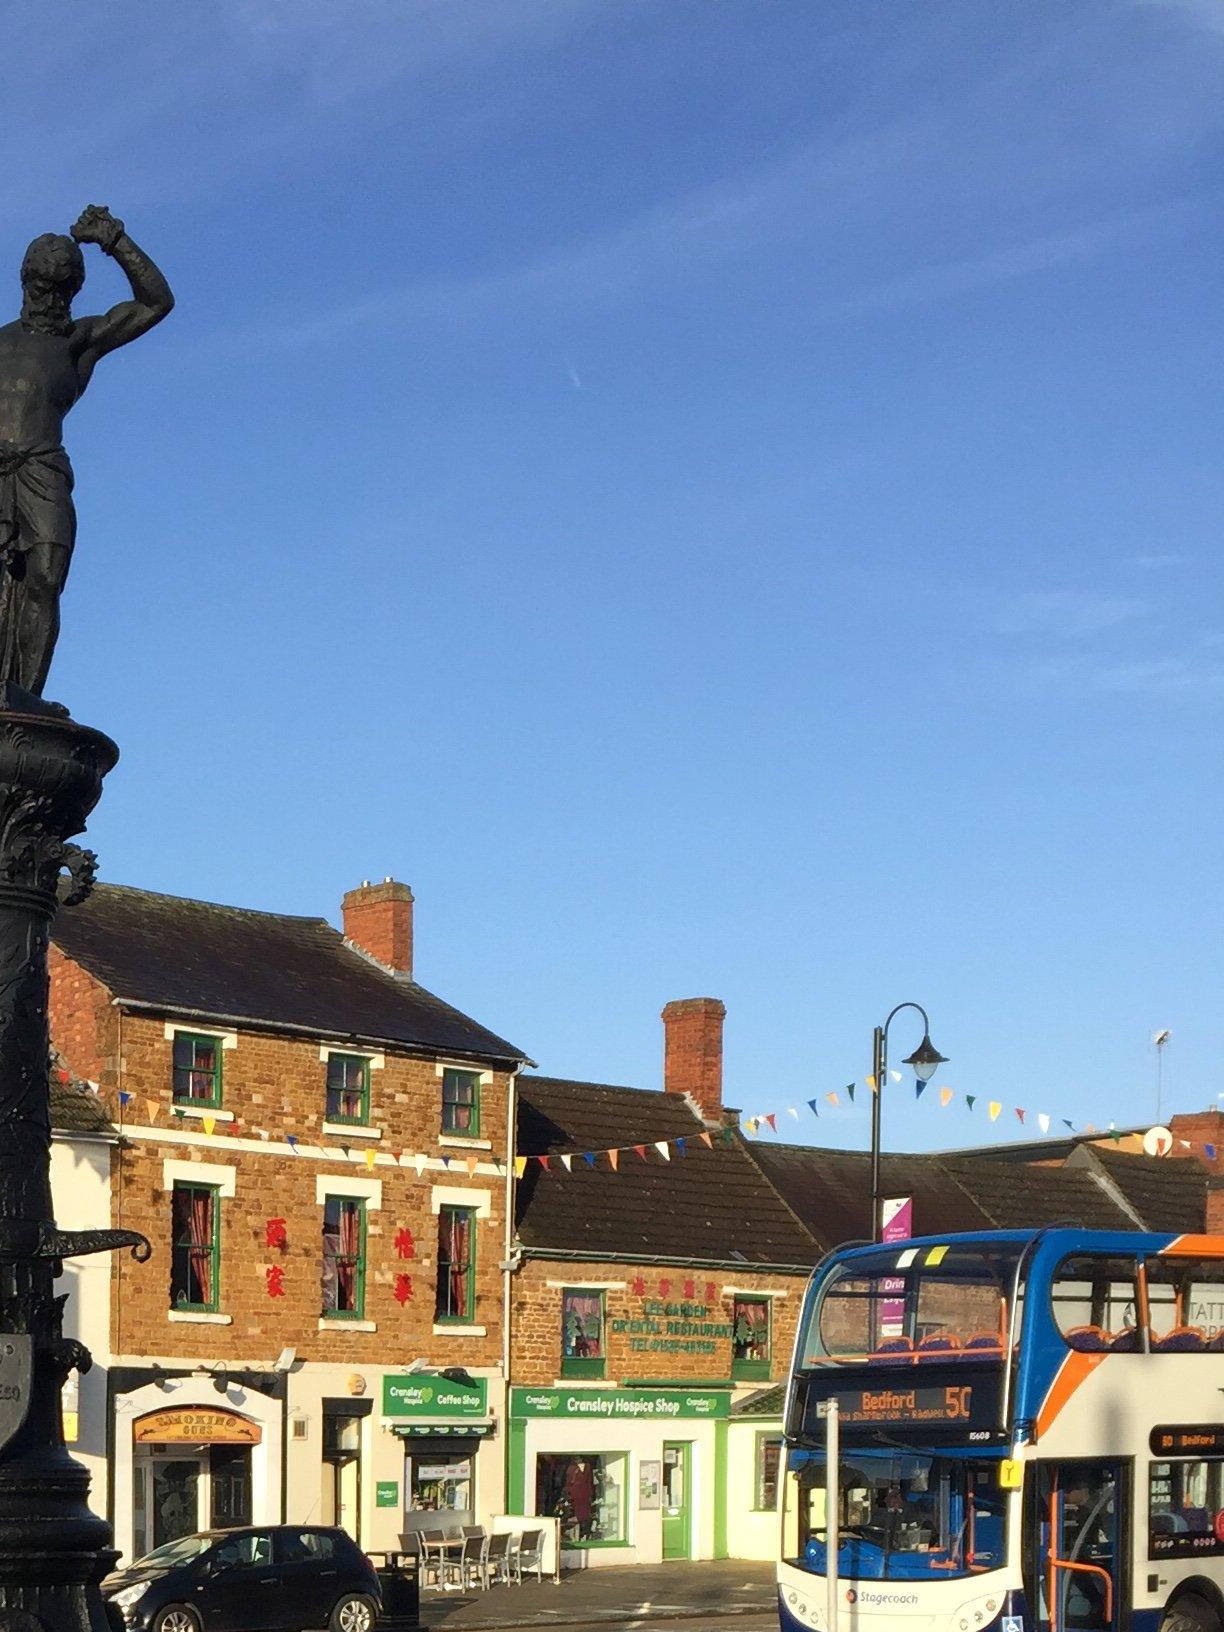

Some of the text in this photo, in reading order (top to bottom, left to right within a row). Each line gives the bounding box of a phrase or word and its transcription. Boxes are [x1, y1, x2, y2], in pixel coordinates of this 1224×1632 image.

[884, 1280, 905, 1291] Drin
[389, 1386, 480, 1407] Cransley Coffee Shop
[861, 1390, 915, 1410] Bedford
[567, 1397, 614, 1416] Cransley
[615, 1398, 654, 1416] Hospice
[655, 1399, 680, 1416] Shop
[155, 1414, 237, 1427] SMOKING
[1180, 1434, 1216, 1447] Bedford
[860, 1591, 918, 1606] Stagecoach
